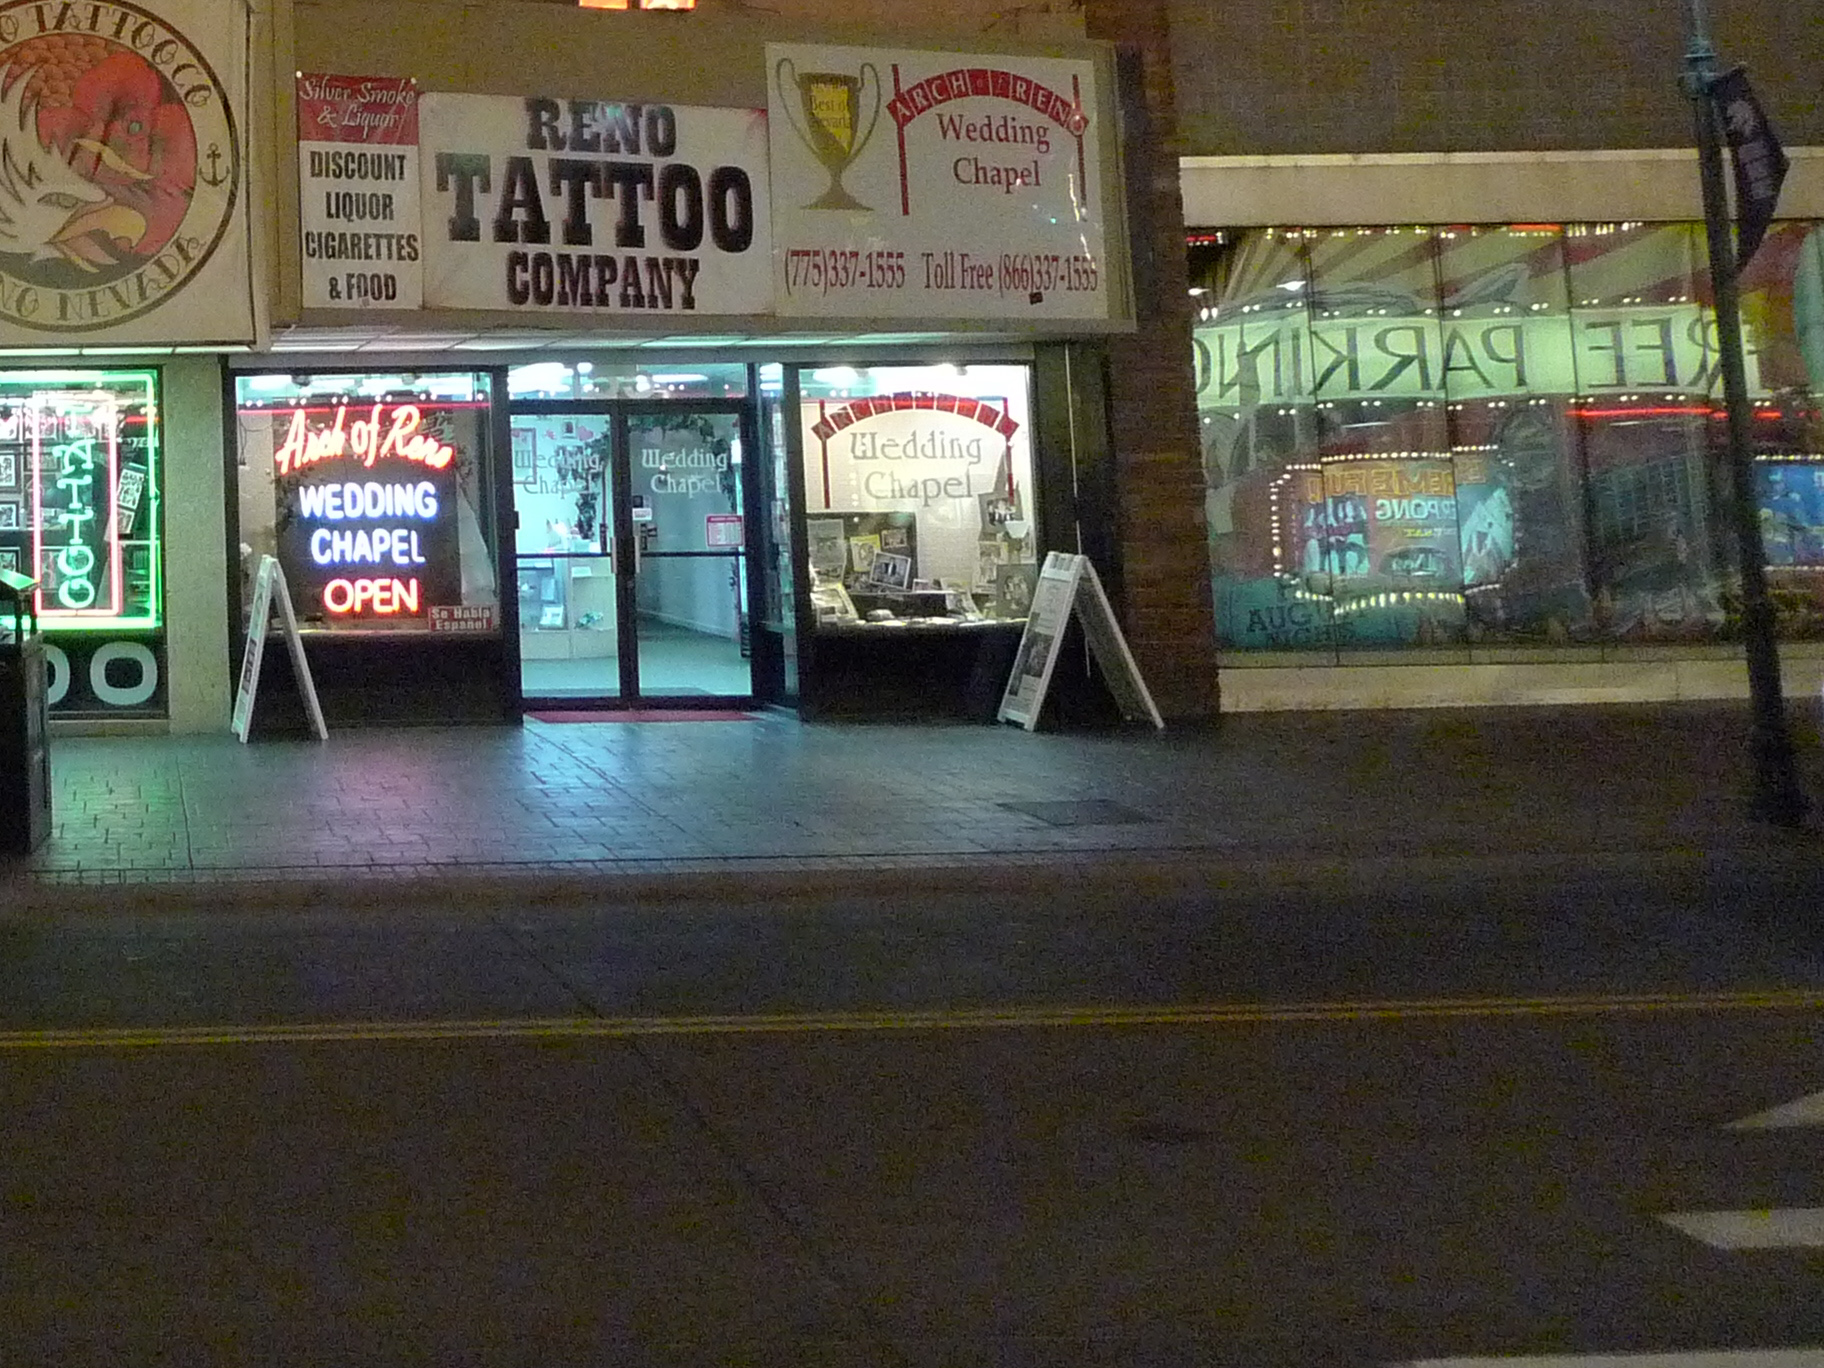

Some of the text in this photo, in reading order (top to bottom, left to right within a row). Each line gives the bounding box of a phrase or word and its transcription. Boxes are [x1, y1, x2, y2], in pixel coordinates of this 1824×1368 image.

[27, 0, 179, 67] TATTOO
[298, 75, 416, 108] Silver Smoke
[896, 73, 966, 116] ARCH
[1016, 79, 1085, 138] RENO
[316, 104, 400, 139] & Liquor
[524, 96, 677, 158] RENO
[936, 112, 1051, 154] Wedding
[309, 150, 406, 181] DISCOUNT
[952, 157, 1042, 195] Chapel
[325, 192, 394, 222] LIQUOR
[435, 152, 754, 253] TATTOO
[305, 230, 420, 262] CIGARETTES
[56, 234, 208, 322] NEVADA
[328, 272, 397, 303] & FOOD
[506, 249, 700, 310] COMPANY
[784, 246, 1099, 299] (775)337-1555 Toll Free (866)337-1555
[276, 405, 346, 475] Arch
[380, 404, 454, 469] Reno
[849, 430, 983, 466] Wedding
[514, 448, 600, 471] Wedding
[641, 447, 728, 473] Wedding
[299, 481, 438, 519] WEDDING
[522, 475, 595, 496] Chapel
[650, 473, 723, 499] Chapel
[864, 468, 974, 508] Chapel
[310, 528, 426, 565] CHAPEL
[324, 578, 420, 614] OPEN
[431, 606, 491, 619] Se Habla
